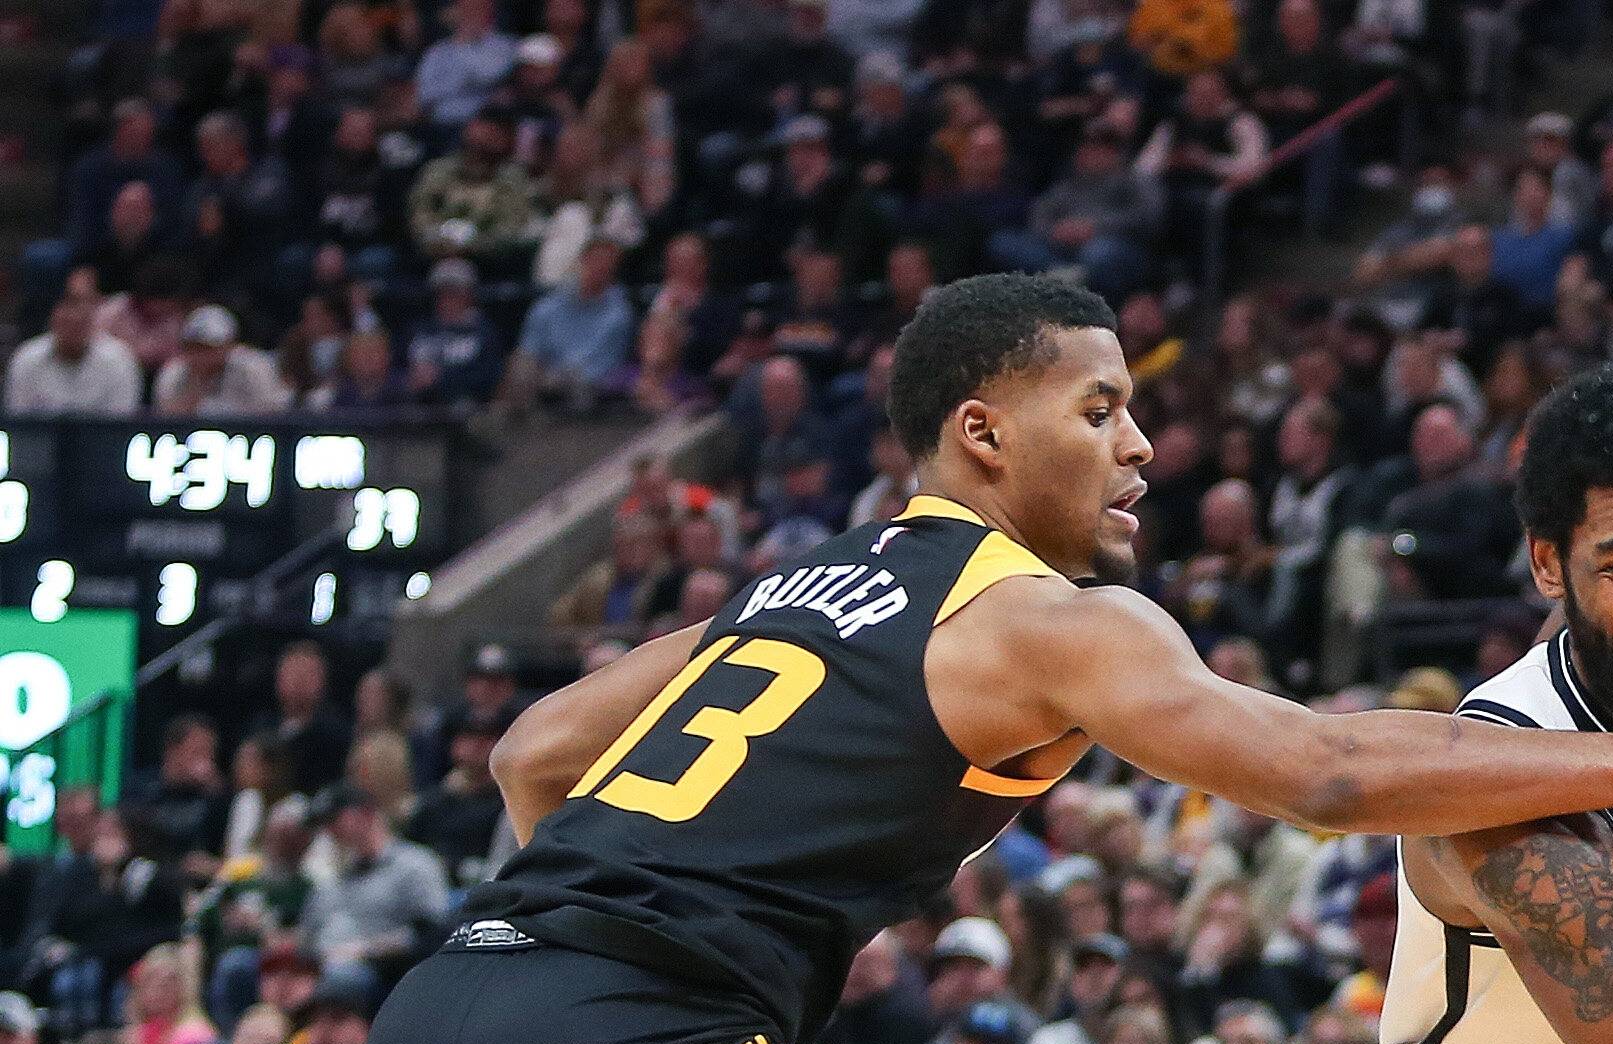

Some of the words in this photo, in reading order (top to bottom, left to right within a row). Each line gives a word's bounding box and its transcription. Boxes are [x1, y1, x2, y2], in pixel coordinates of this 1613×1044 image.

[125, 431, 276, 511] 4:34
[31, 560, 75, 623] 2
[735, 564, 909, 639] BUTLER
[567, 635, 827, 823] 13
